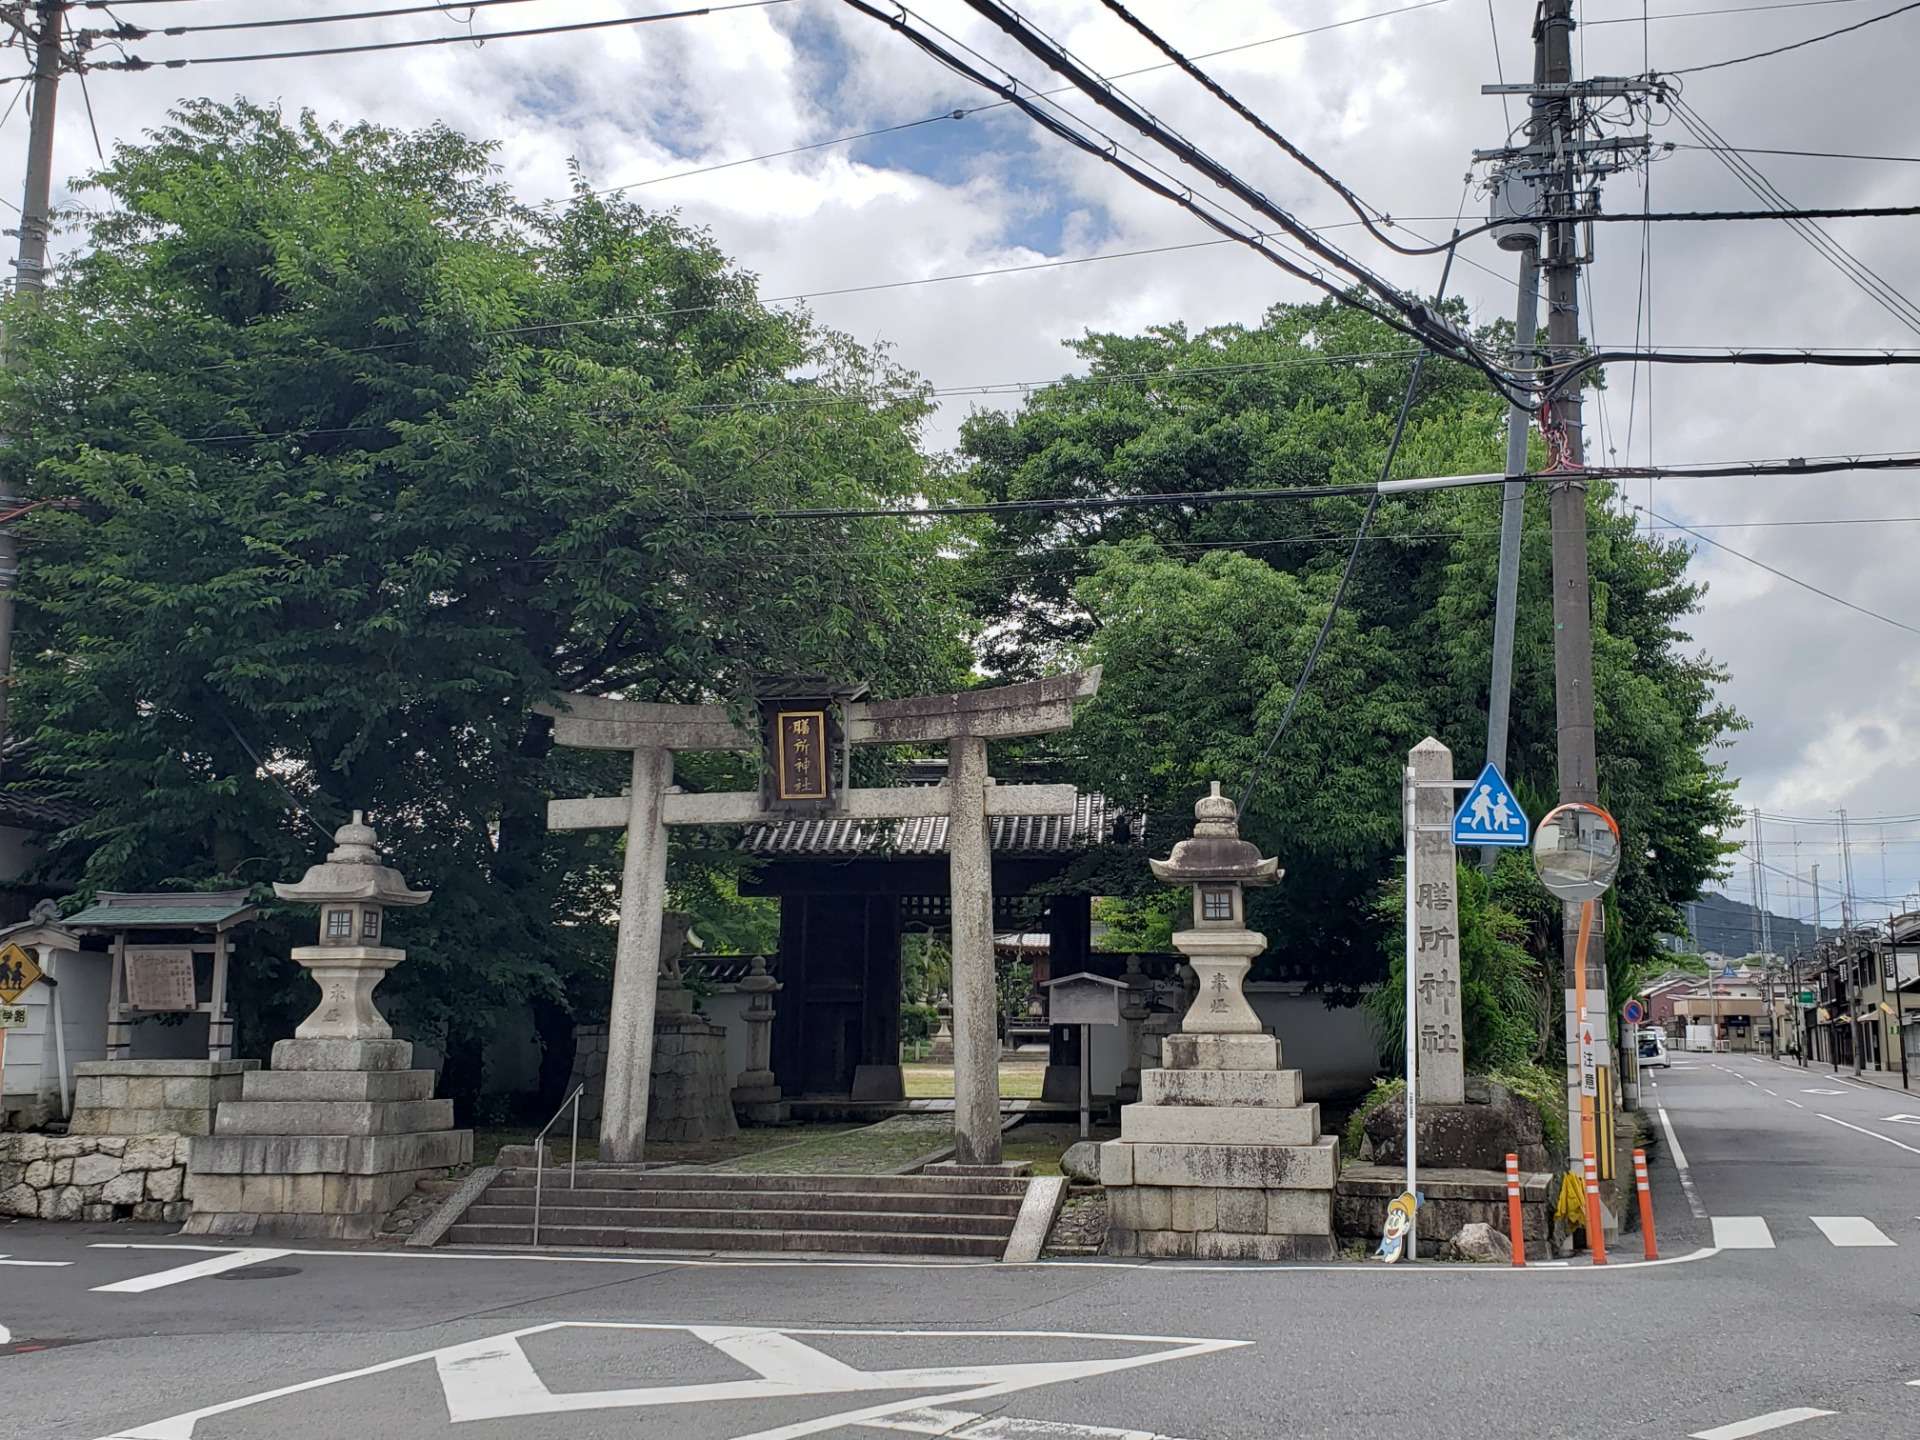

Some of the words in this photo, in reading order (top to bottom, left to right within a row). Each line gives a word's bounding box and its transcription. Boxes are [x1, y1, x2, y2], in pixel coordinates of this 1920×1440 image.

[1416, 882, 1458, 1054] 膳所神社
[0, 1010, 25, 1023] 学路
[1583, 1051, 1595, 1089] 注意
